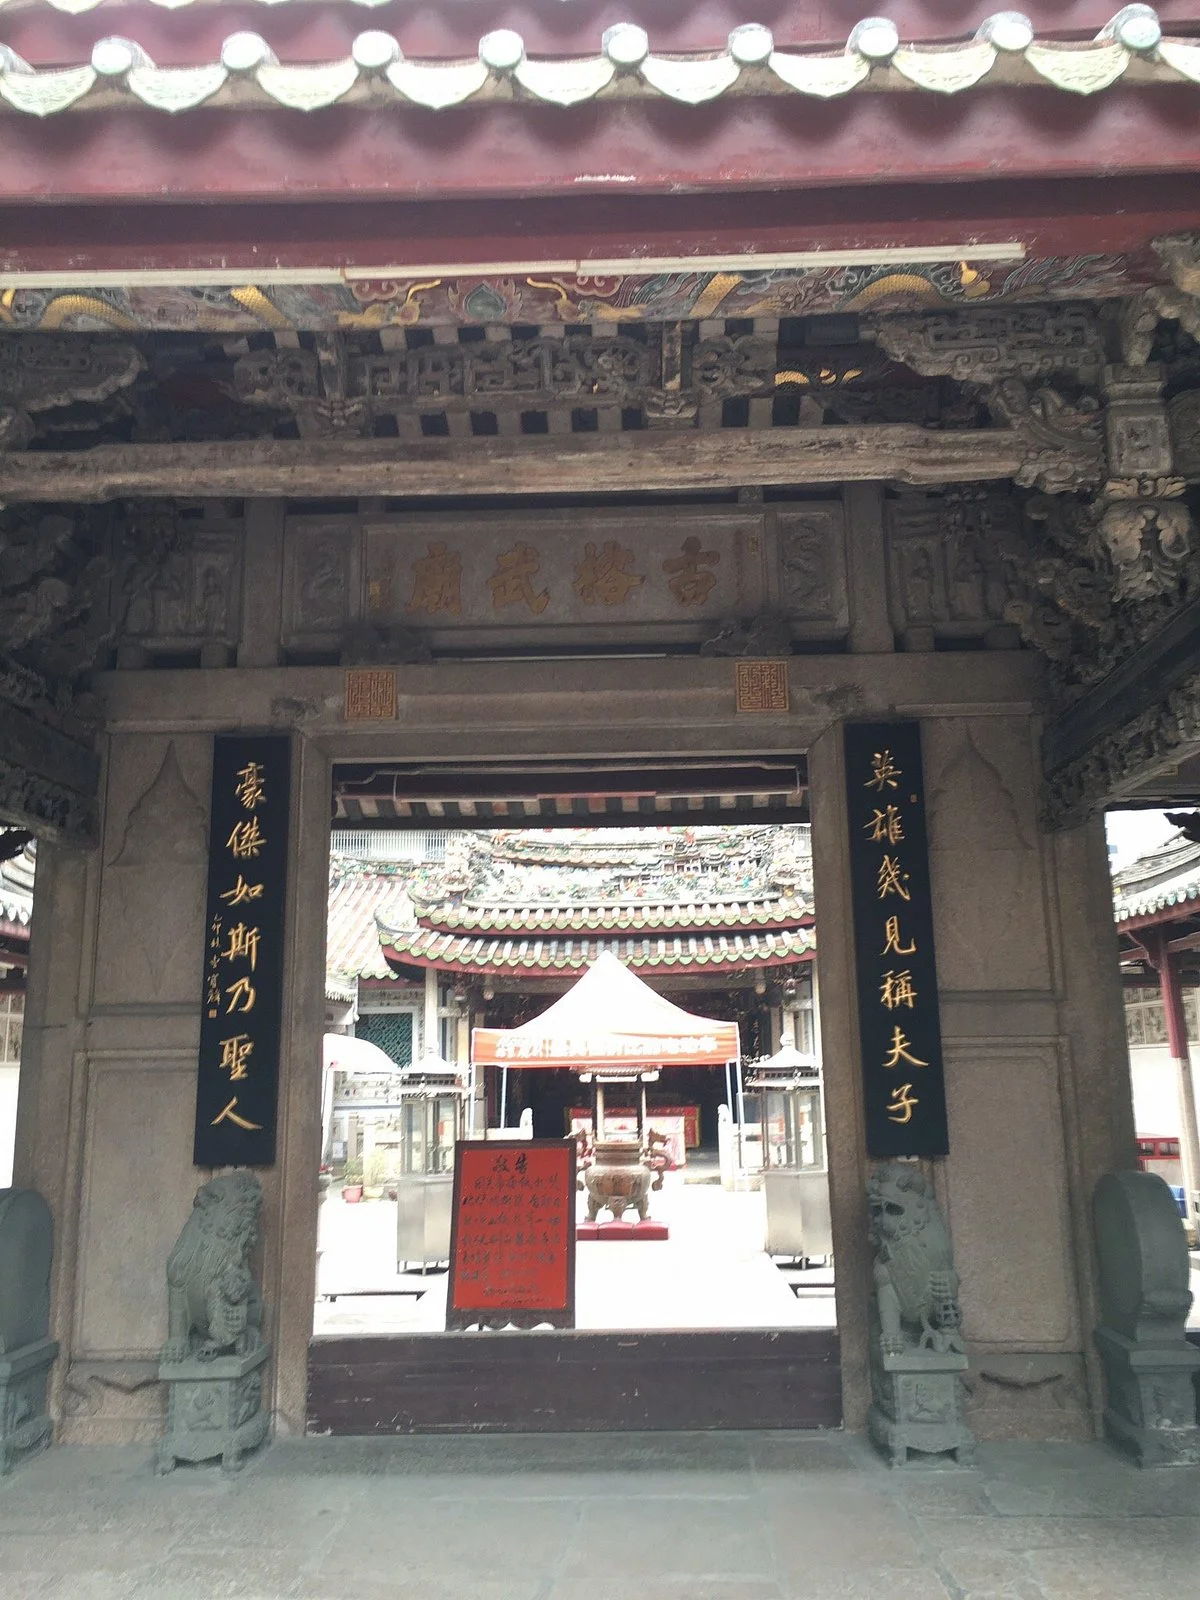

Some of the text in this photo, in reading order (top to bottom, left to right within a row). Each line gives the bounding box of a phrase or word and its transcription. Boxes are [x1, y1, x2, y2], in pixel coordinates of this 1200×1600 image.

[210, 762, 268, 1130] 豪傑如斯乃聖人
[863, 750, 930, 1124] 英雄幾見稱夫子
